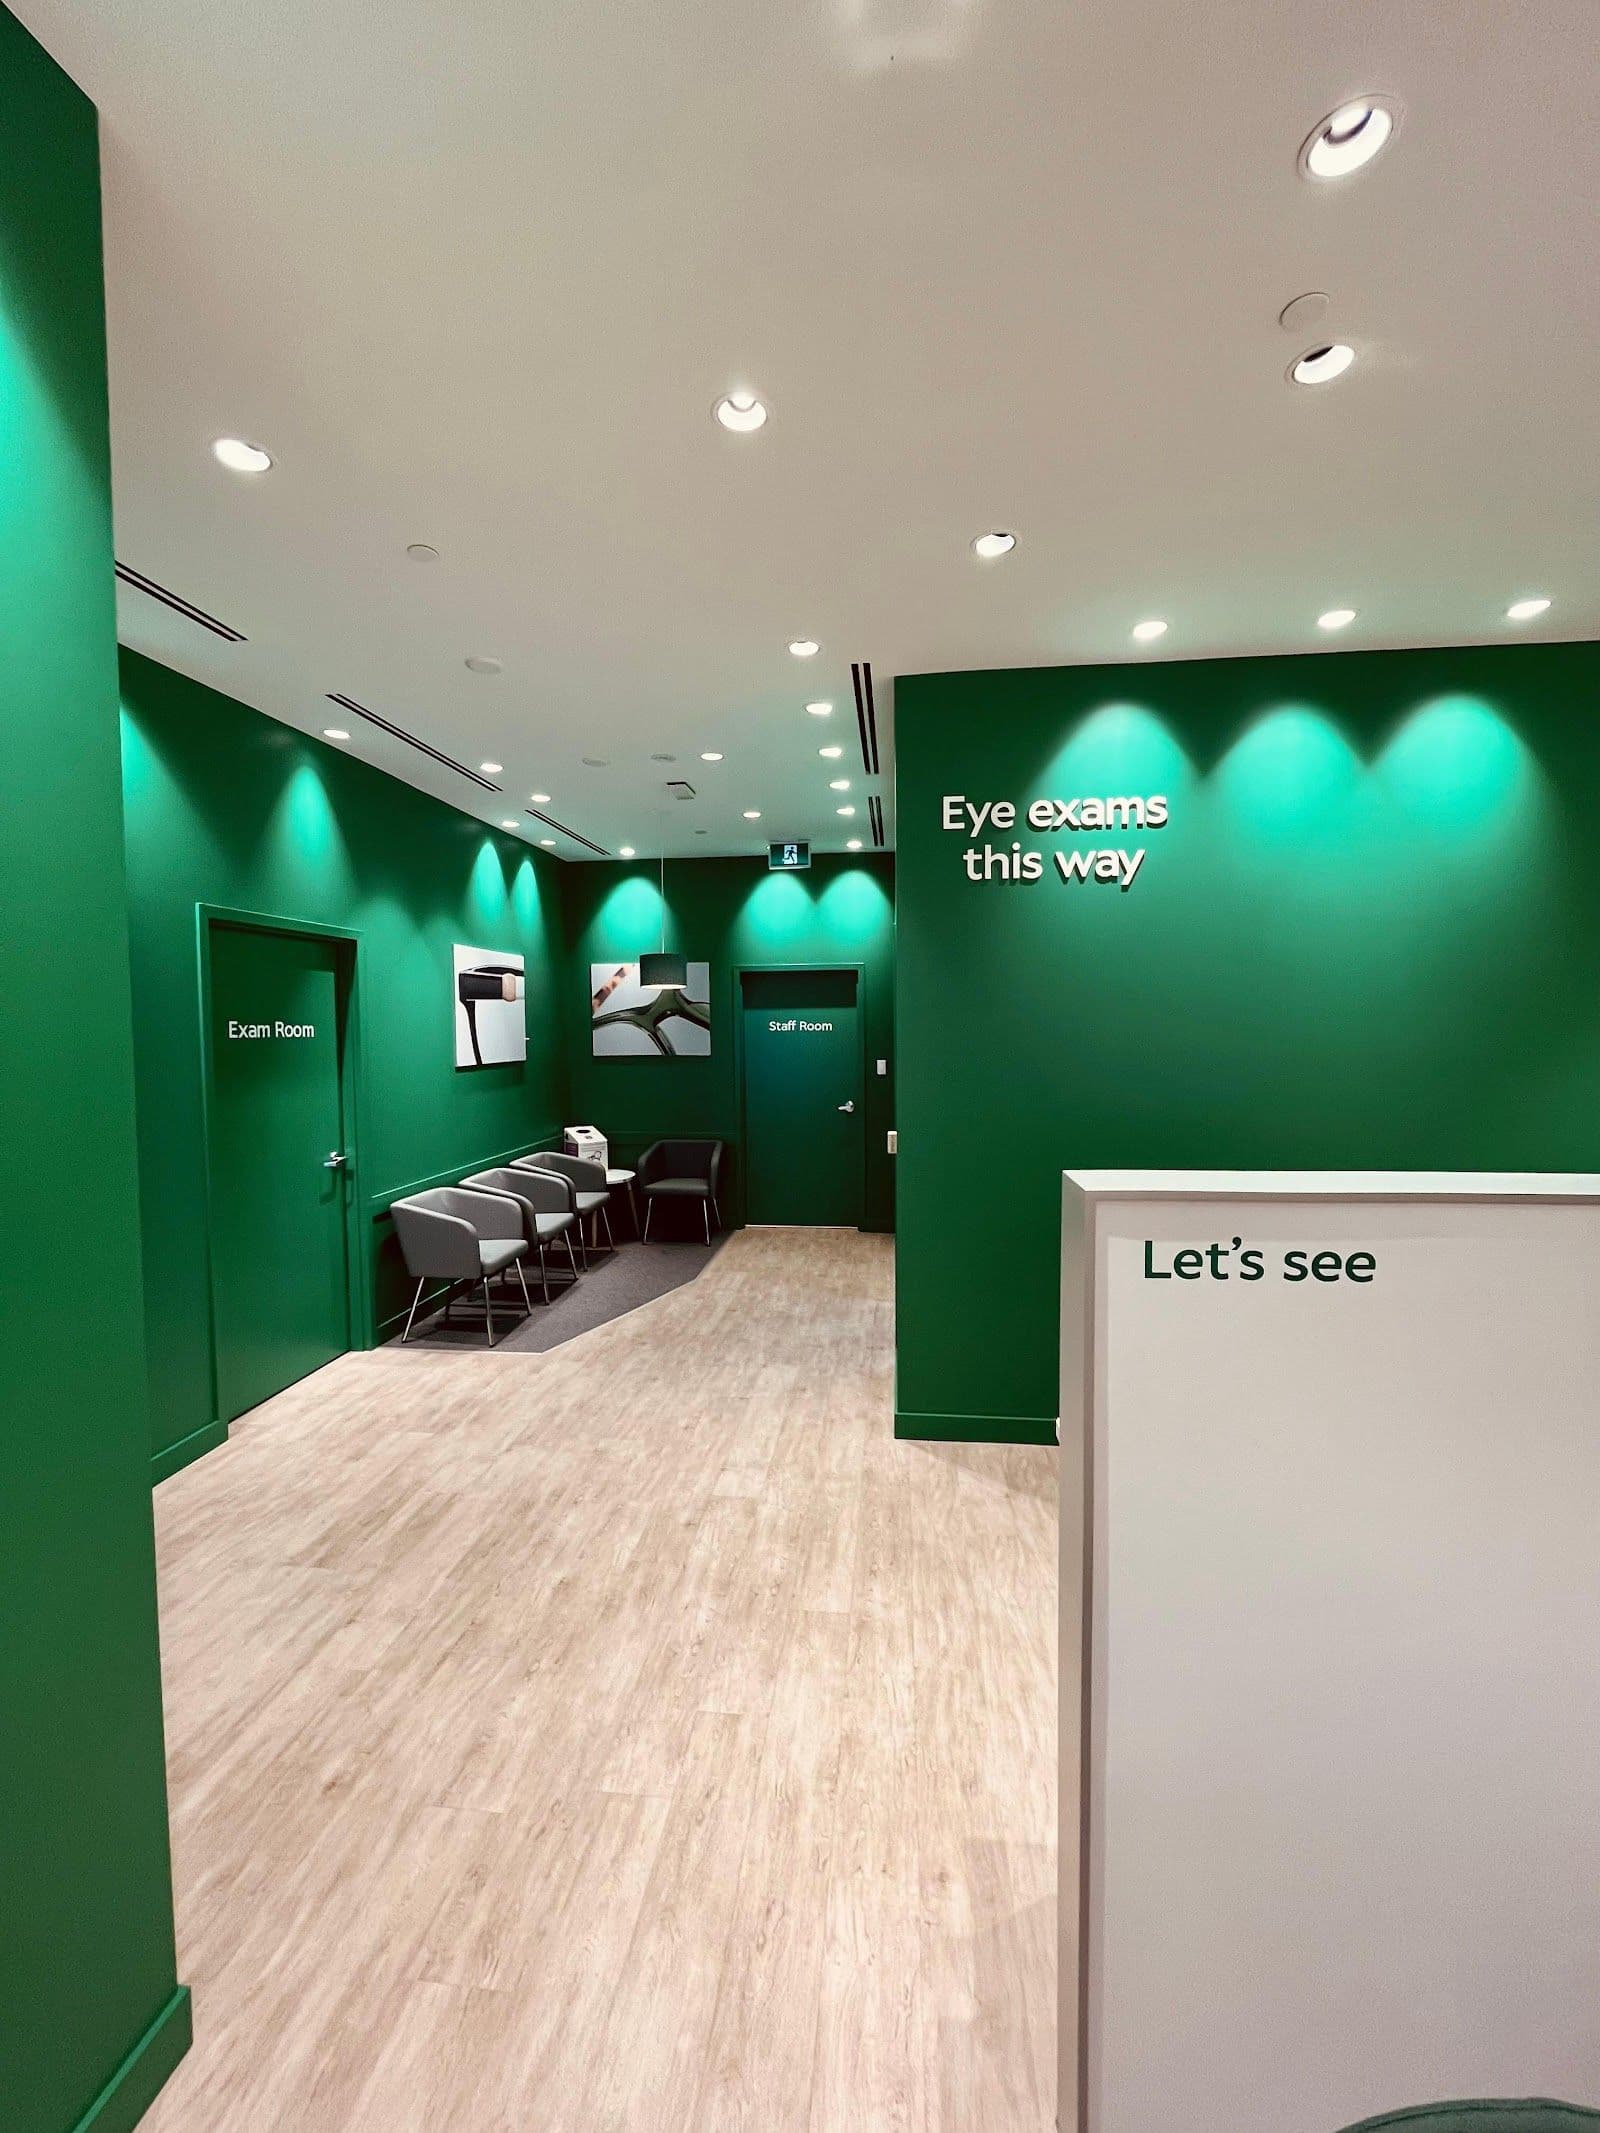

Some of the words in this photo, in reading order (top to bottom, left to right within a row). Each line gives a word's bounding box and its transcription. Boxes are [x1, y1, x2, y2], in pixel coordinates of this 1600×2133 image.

[942, 795, 1016, 838] Eye
[1028, 795, 1169, 828] exams
[963, 841, 1044, 881] this
[1055, 848, 1146, 886] way
[228, 1020, 271, 1039] Exam
[274, 1020, 315, 1038] Room
[768, 1019, 797, 1032] Staff
[799, 1020, 833, 1032] Room
[1143, 1236, 1265, 1281] Let’s
[1283, 1250, 1377, 1283] see
